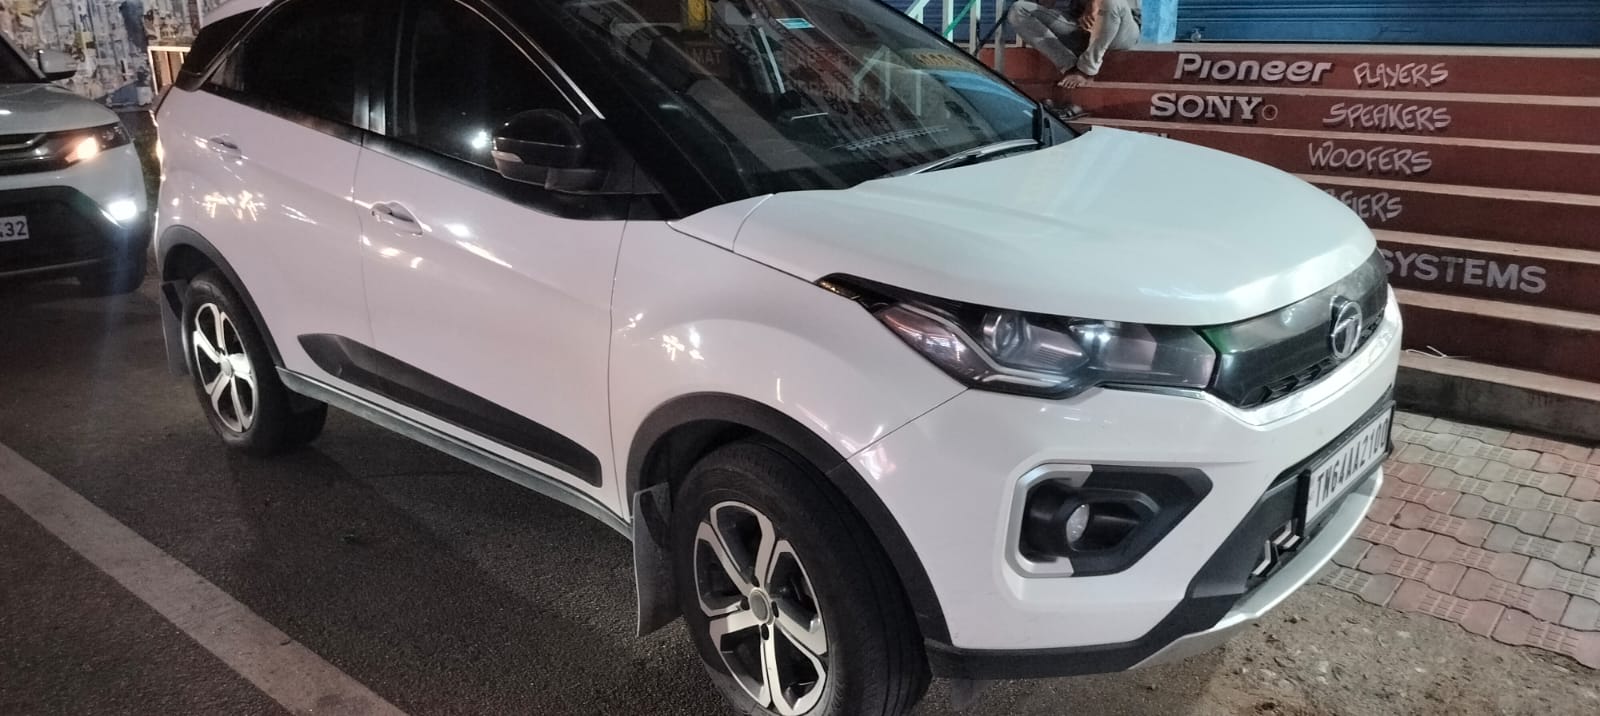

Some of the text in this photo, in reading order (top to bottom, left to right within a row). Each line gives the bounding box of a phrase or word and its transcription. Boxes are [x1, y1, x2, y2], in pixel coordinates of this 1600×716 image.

[1174, 52, 1448, 88] Pioneer PLAYERS
[1150, 93, 1451, 131] SONY SPEAKERS
[1308, 141, 1432, 175] WOOFERS
[1325, 188, 1403, 222] FIERS
[0, 220, 27, 238] 32
